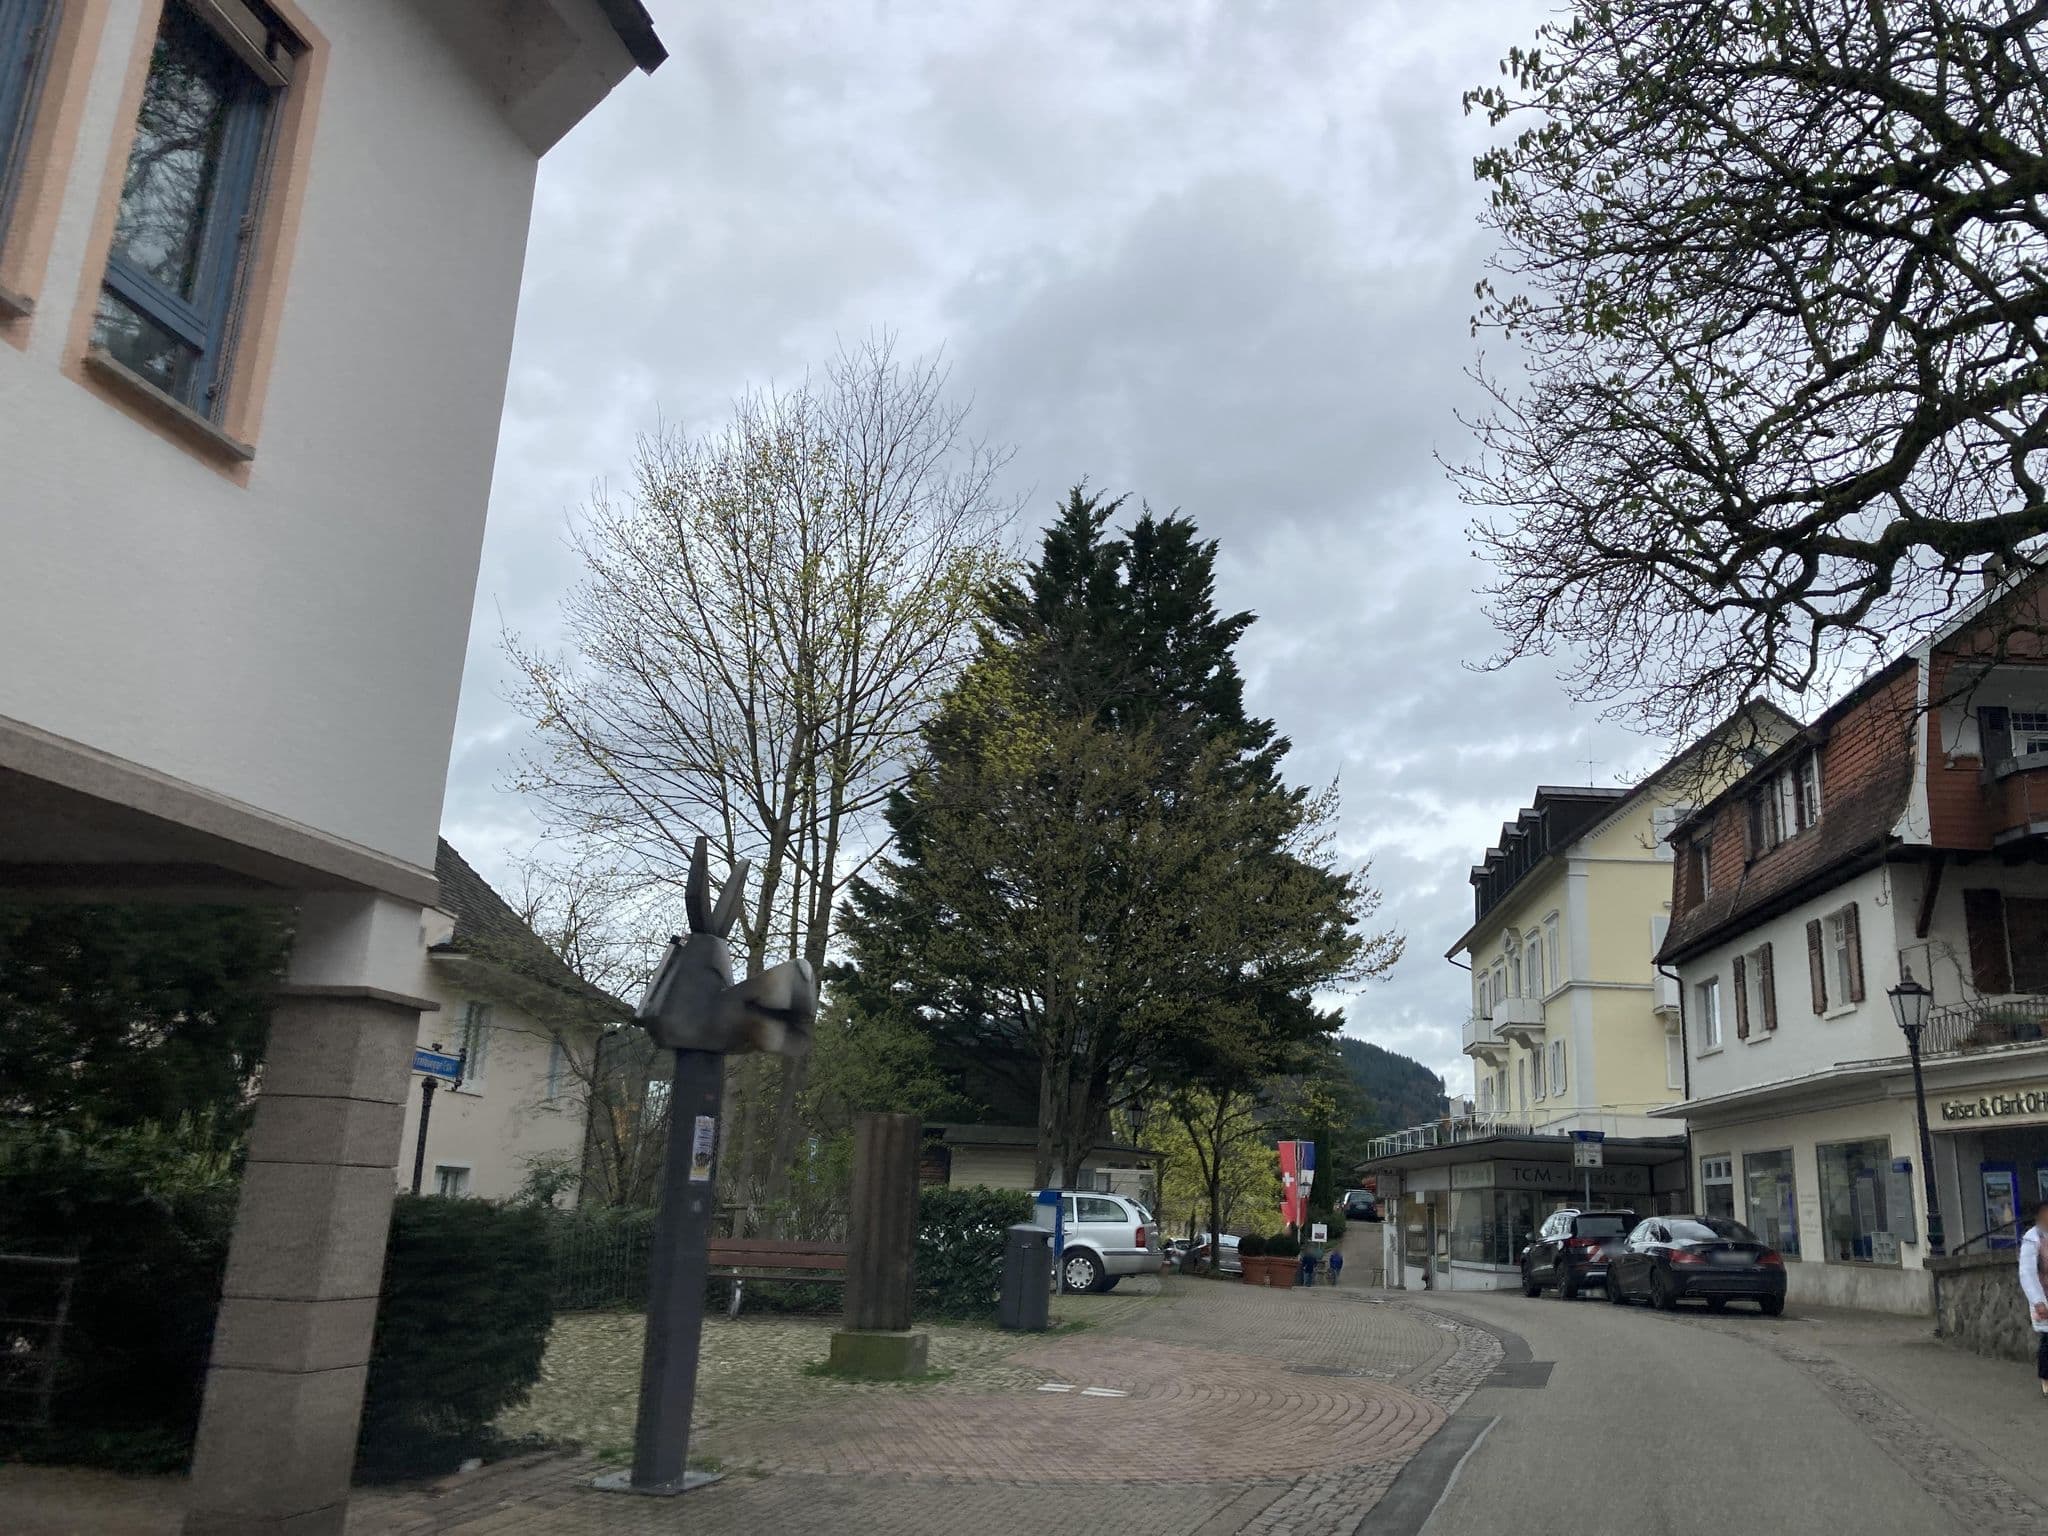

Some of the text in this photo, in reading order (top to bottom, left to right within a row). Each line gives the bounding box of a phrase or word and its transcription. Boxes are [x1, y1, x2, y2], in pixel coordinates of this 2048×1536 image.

[1941, 1092, 2048, 1120] Kaiser & Clark OH
[1512, 1167, 1551, 1183] TCM
